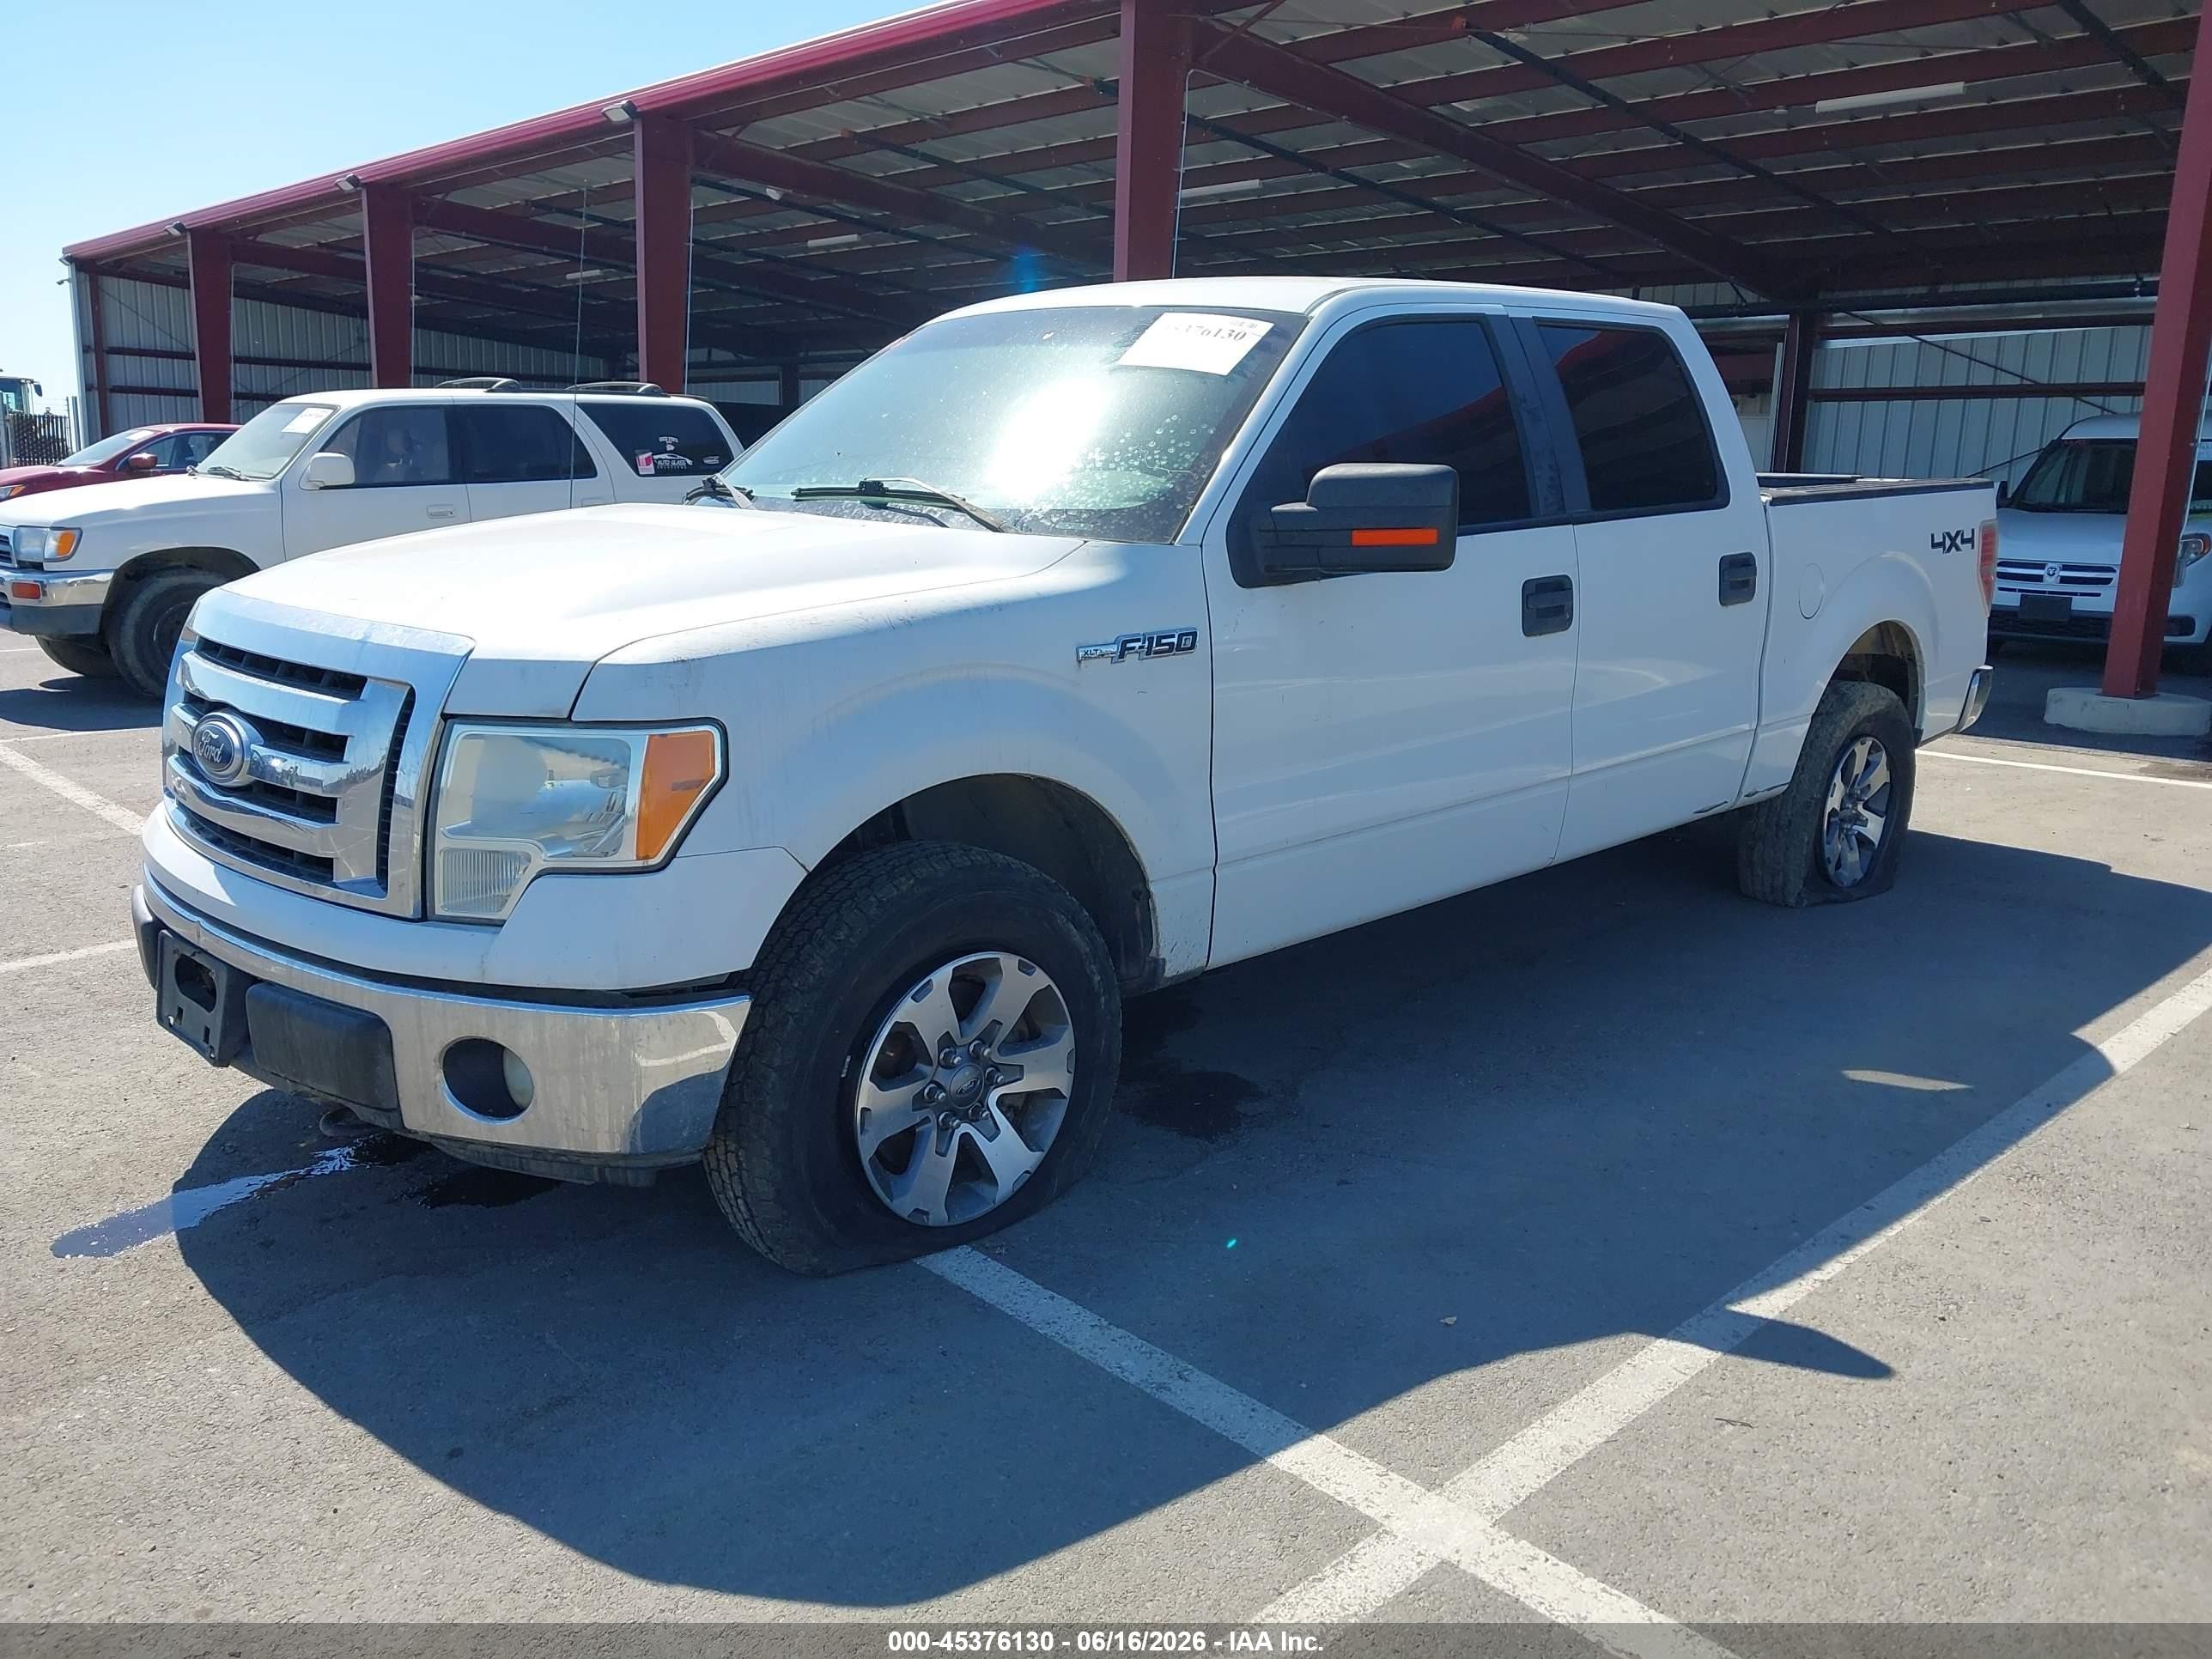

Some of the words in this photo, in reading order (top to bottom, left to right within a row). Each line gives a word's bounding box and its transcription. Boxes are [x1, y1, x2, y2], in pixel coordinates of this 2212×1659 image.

[1168, 323, 1248, 342] 376130
[1083, 648, 1099, 657] XLT
[1115, 630, 1199, 660] F-150
[198, 729, 225, 763] Ford
